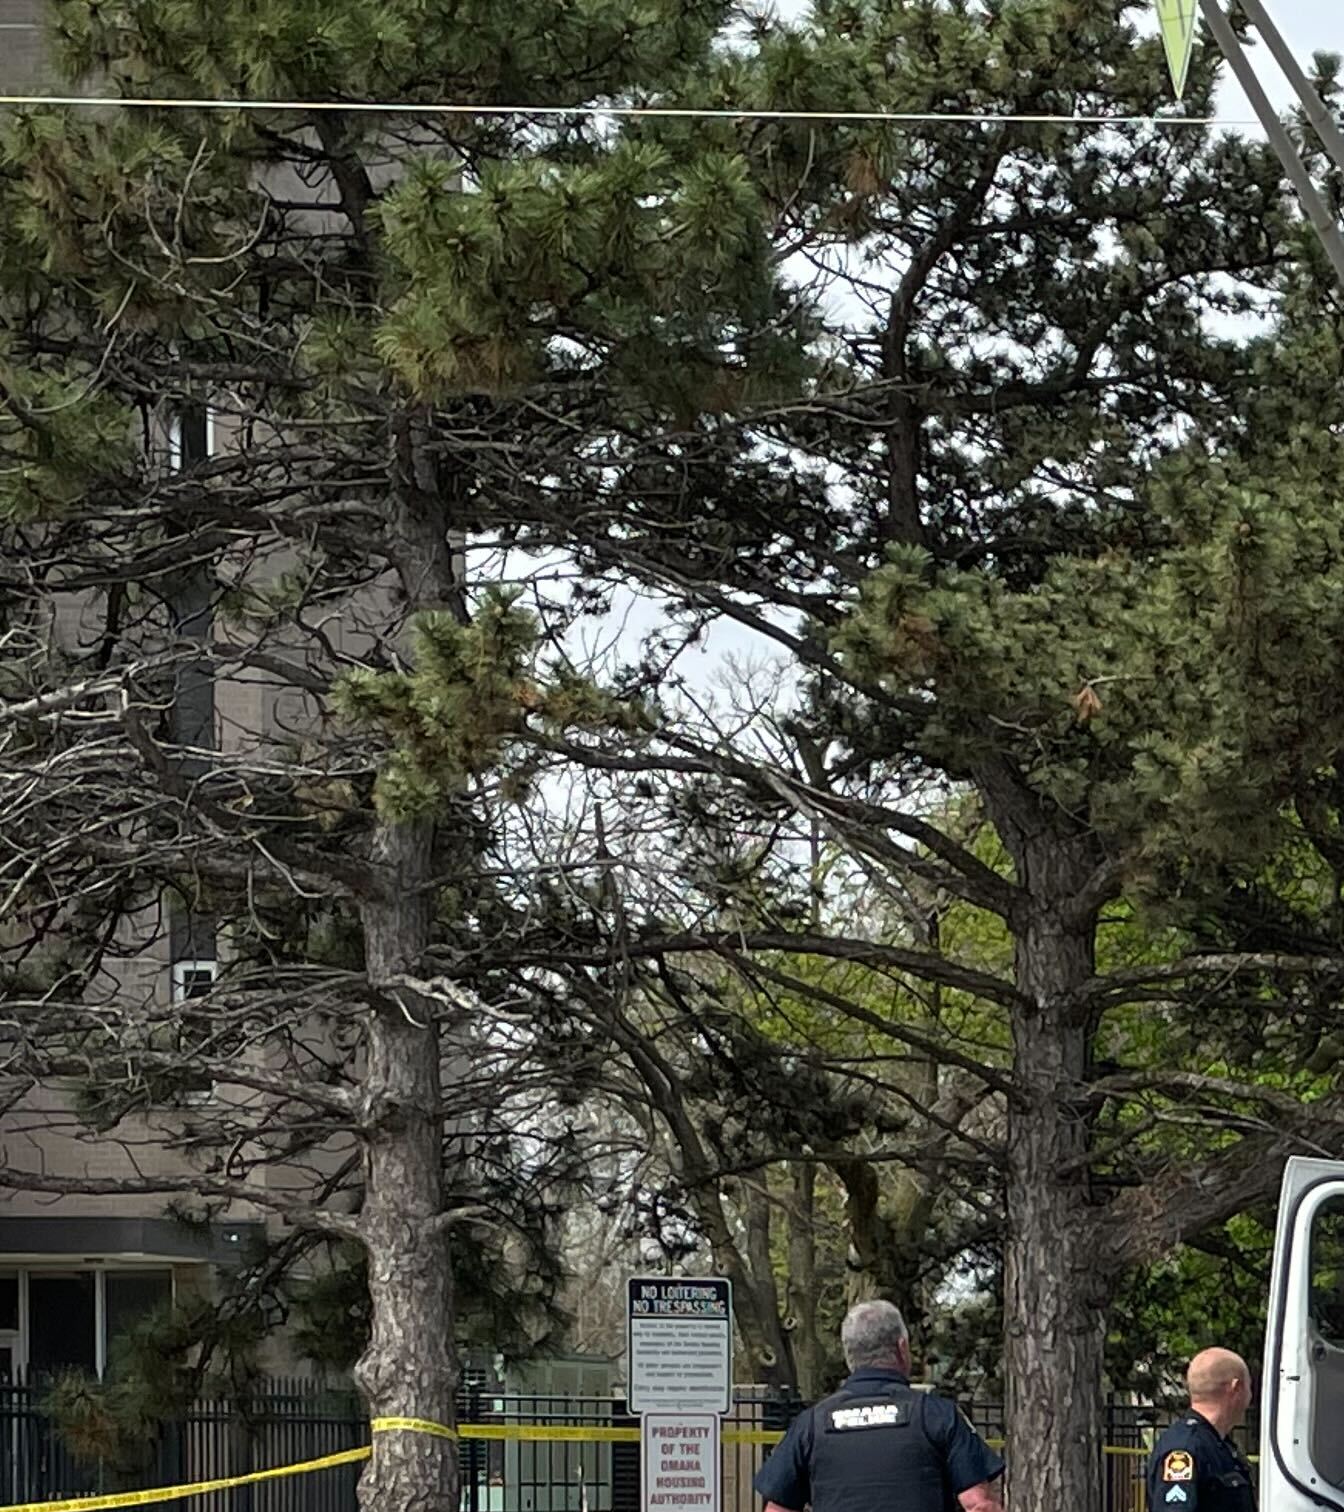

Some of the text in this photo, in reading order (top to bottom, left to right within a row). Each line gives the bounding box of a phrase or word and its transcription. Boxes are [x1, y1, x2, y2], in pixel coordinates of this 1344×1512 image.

[641, 1286, 718, 1300] NO LOITERING
[633, 1300, 726, 1314] NO TRESPASSING
[651, 1426, 711, 1438] PROPERTY
[660, 1443, 701, 1455] OF THE
[660, 1460, 702, 1472] OMAHA
[656, 1477, 706, 1489] HOUSING
[650, 1493, 712, 1505] AUTHORITY
